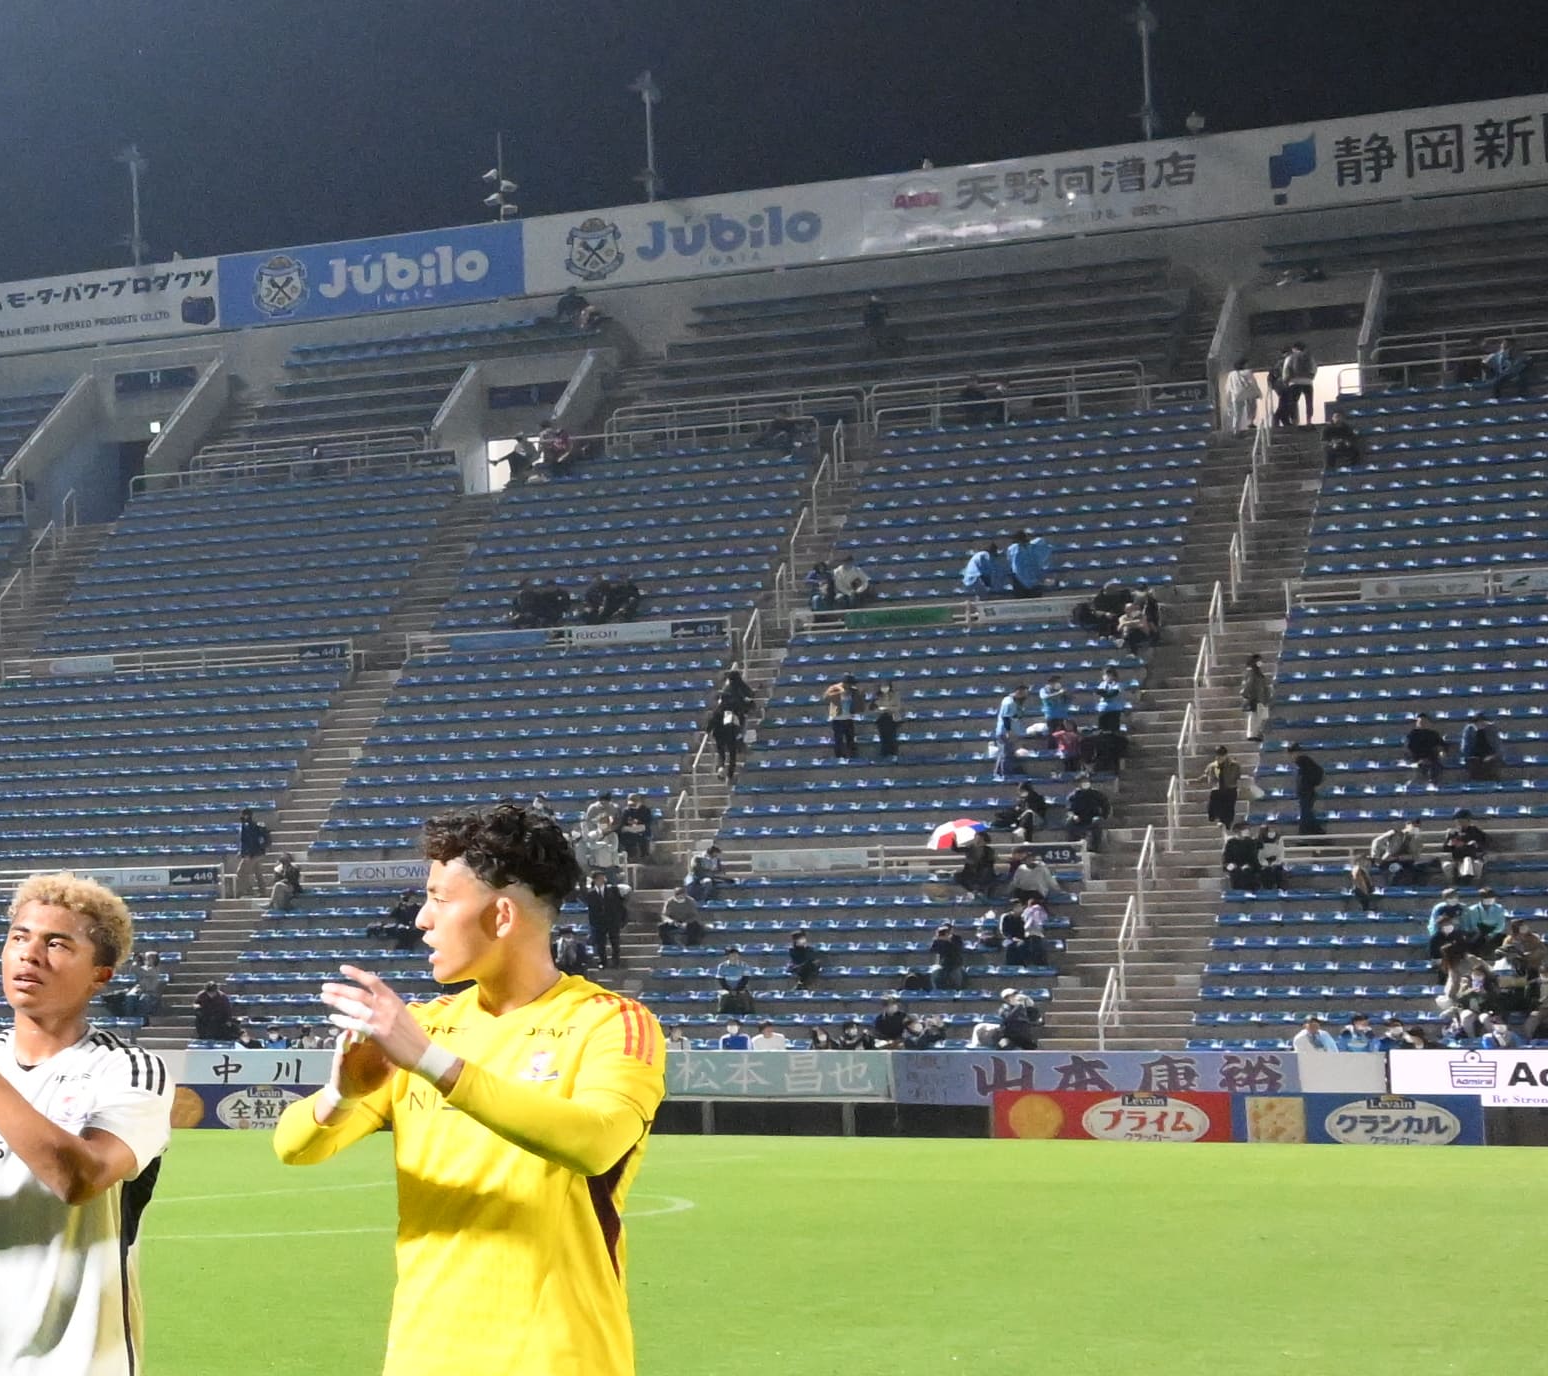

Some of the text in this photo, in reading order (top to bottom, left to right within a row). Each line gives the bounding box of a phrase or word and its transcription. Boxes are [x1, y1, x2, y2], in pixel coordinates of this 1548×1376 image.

[1333, 113, 1548, 187] 静岡新
[635, 204, 823, 262] Júbilo
[318, 245, 490, 299] Júbilo
[675, 1053, 875, 1094] 松本昌也
[971, 1054, 1284, 1096] 山本康裕
[1099, 1108, 1194, 1133] プライム
[1122, 1094, 1168, 1108] Levain
[1366, 1096, 1416, 1110] Levain
[1336, 1112, 1449, 1136] クラシカル
